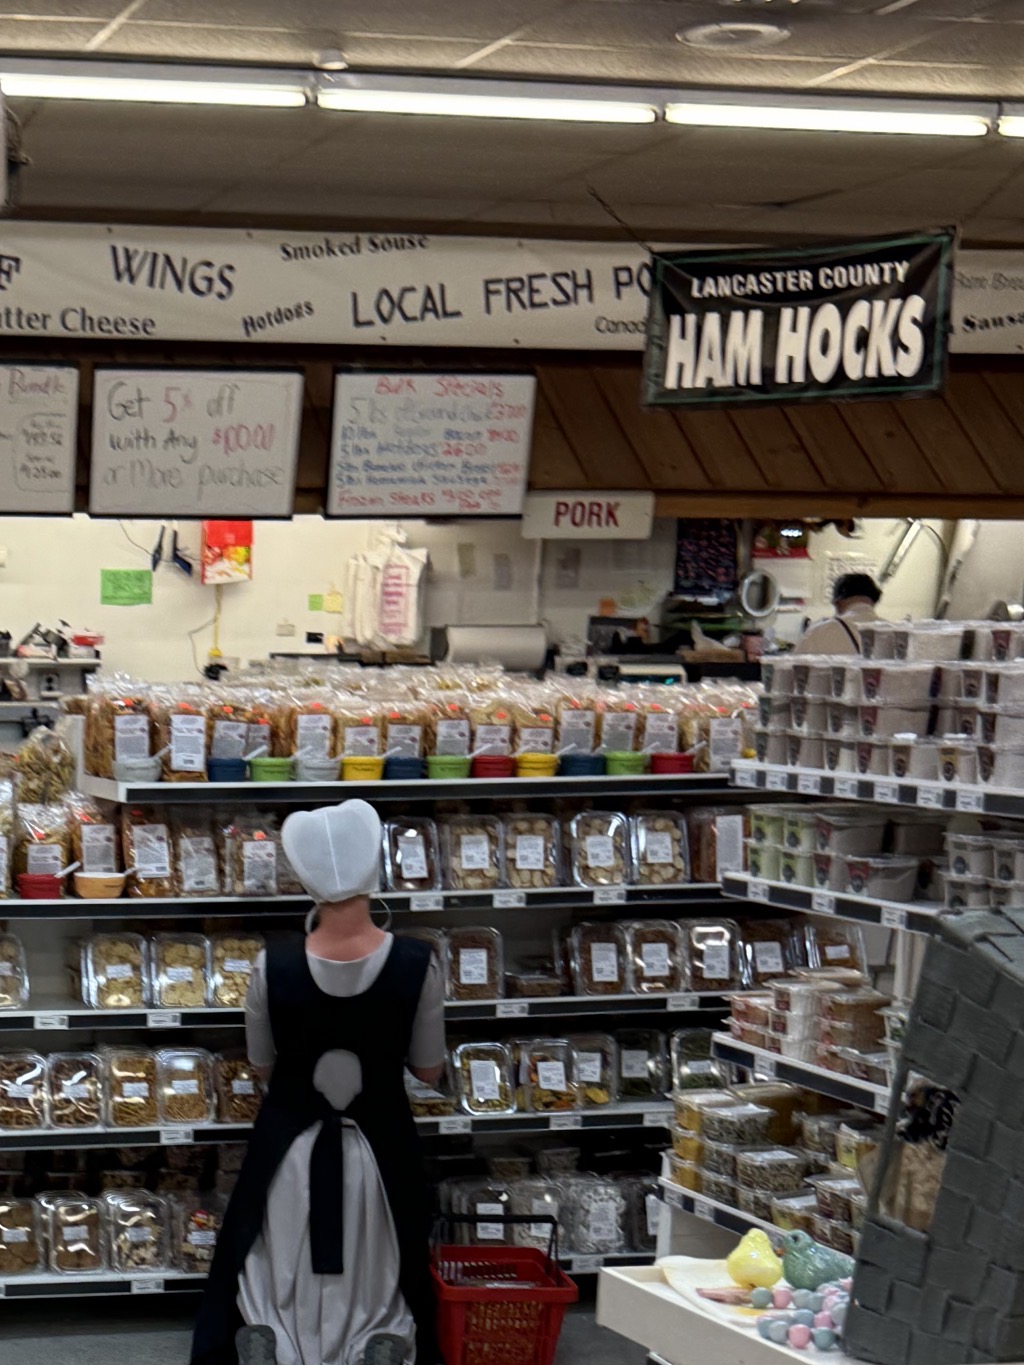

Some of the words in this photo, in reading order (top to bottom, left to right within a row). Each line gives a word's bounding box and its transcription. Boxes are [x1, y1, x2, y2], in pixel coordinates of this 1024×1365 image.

[280, 232, 362, 262] Smoked
[368, 234, 431, 252] Souse
[110, 243, 237, 300] WINGS
[690, 269, 814, 299] LANCASTER
[818, 261, 910, 290] COUNTY
[351, 283, 462, 328] LOCAL
[483, 268, 593, 315] FRESH
[60, 306, 157, 336] Cheese
[664, 308, 763, 390] HAM
[774, 294, 925, 384] HOCKS
[107, 381, 151, 421] Get
[553, 501, 620, 529] PORK
